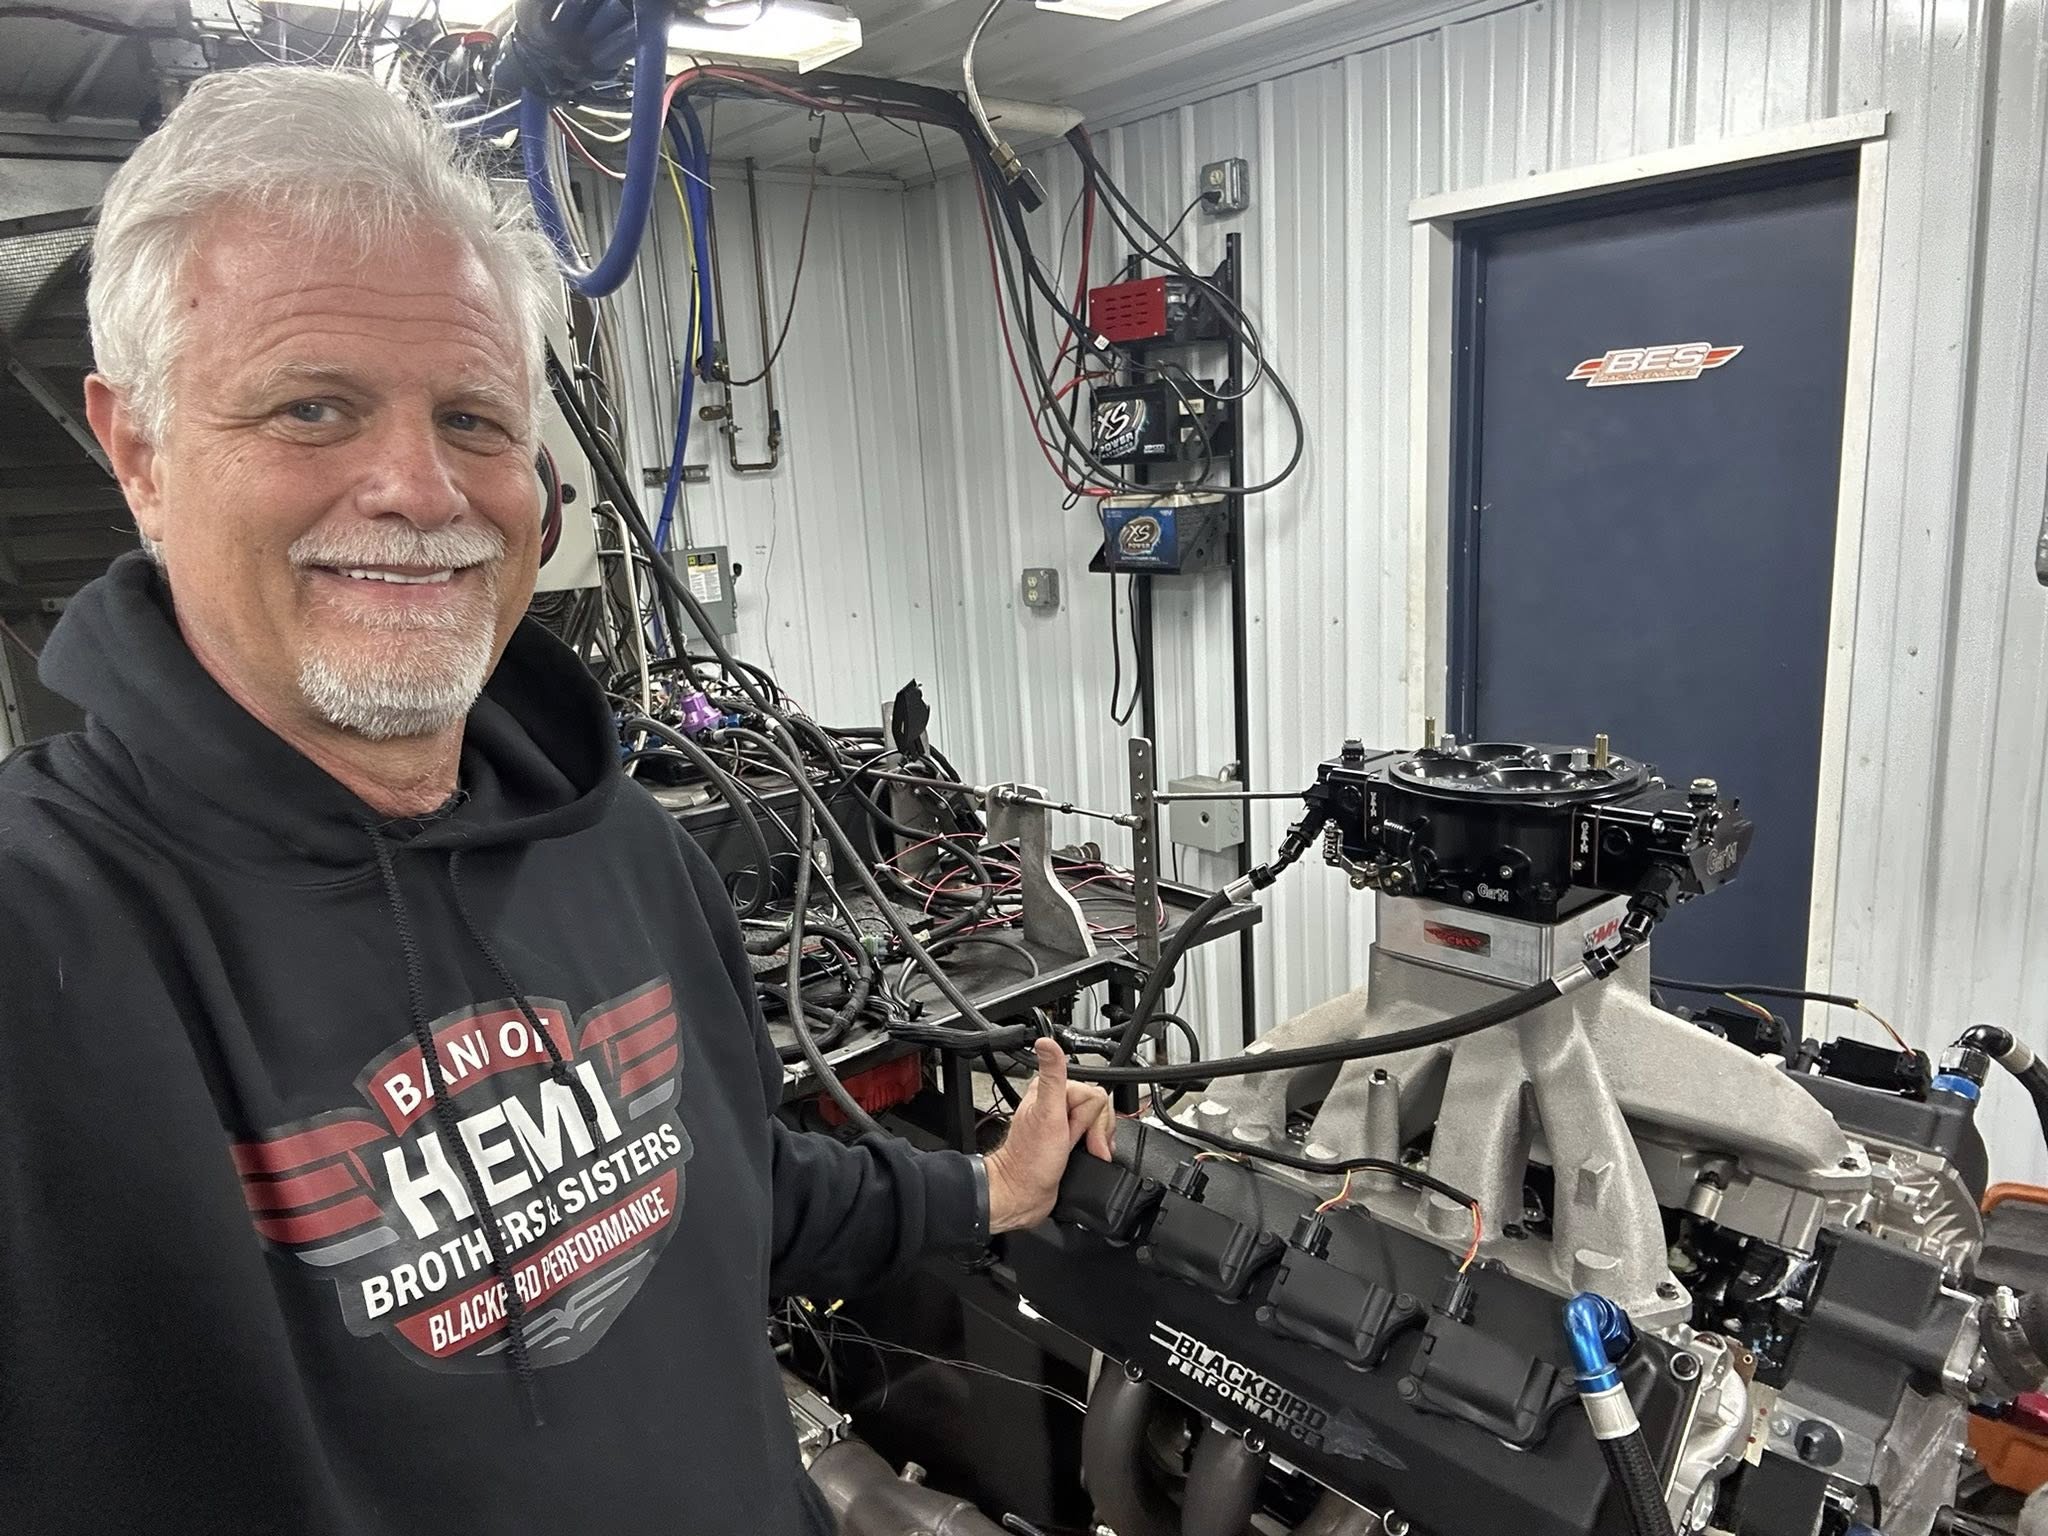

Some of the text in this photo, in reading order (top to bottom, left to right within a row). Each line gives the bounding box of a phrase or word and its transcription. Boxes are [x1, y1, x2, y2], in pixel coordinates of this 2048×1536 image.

[1604, 344, 1707, 373] BES
[1097, 401, 1130, 440] XS
[1100, 432, 1134, 452] POWER
[1125, 524, 1151, 543] XS
[382, 1060, 623, 1240] HEMI
[546, 1195, 562, 1226] &
[557, 1123, 682, 1214] SISTERS
[429, 1186, 671, 1352] BLACKBRD PERFORMANCE
[1167, 1354, 1325, 1449] PERFORMANCE
[1175, 1332, 1329, 1431] BLACKBIRD
